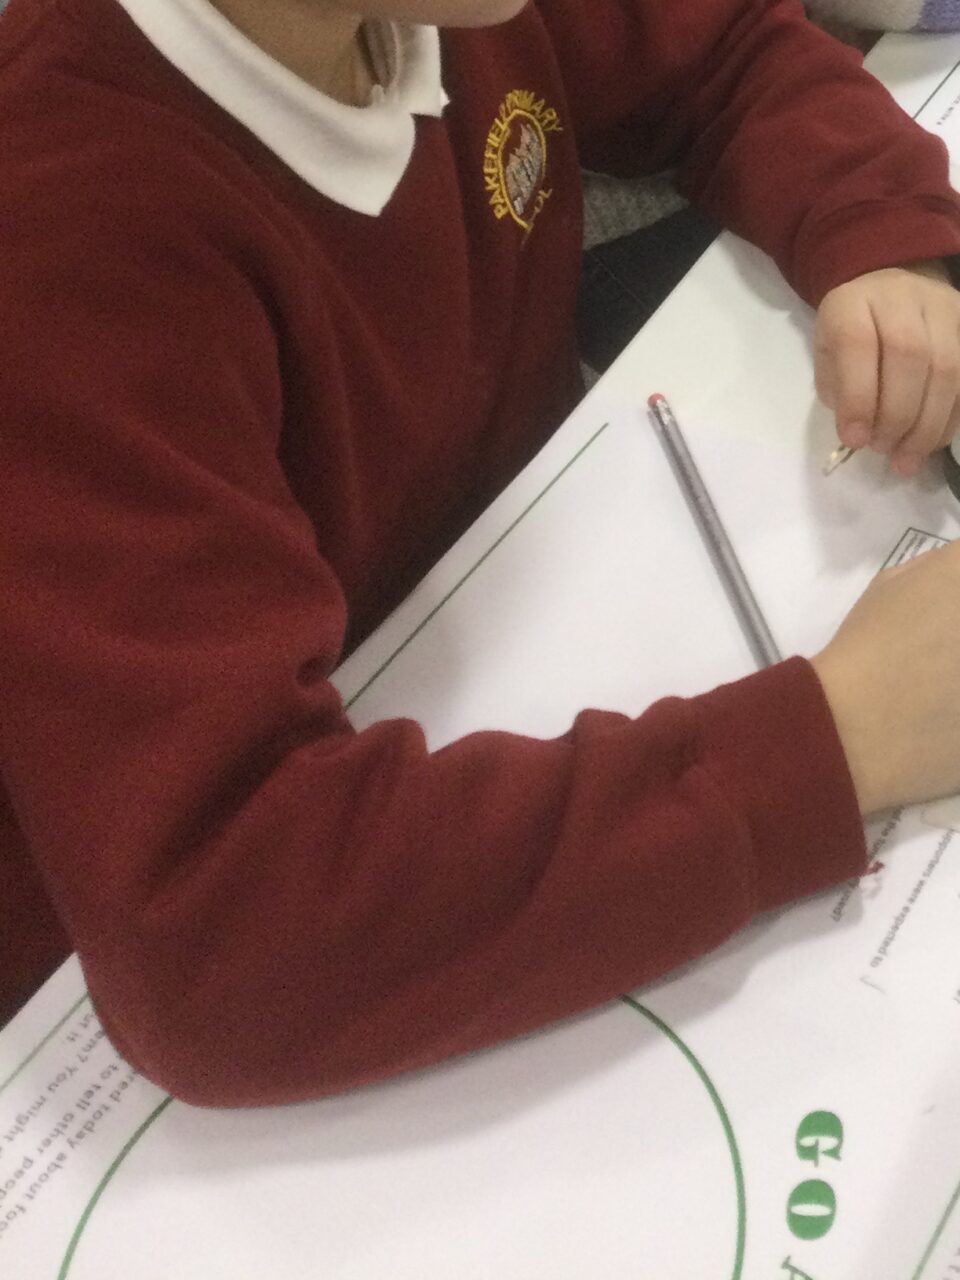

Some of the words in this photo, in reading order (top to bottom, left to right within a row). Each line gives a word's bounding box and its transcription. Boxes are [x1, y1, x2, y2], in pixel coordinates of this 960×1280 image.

[4, 1094, 51, 1148] might
[76, 1084, 102, 1111] tell
[38, 1108, 78, 1153] other
[64, 1104, 111, 1153] today
[24, 1152, 68, 1200] about
